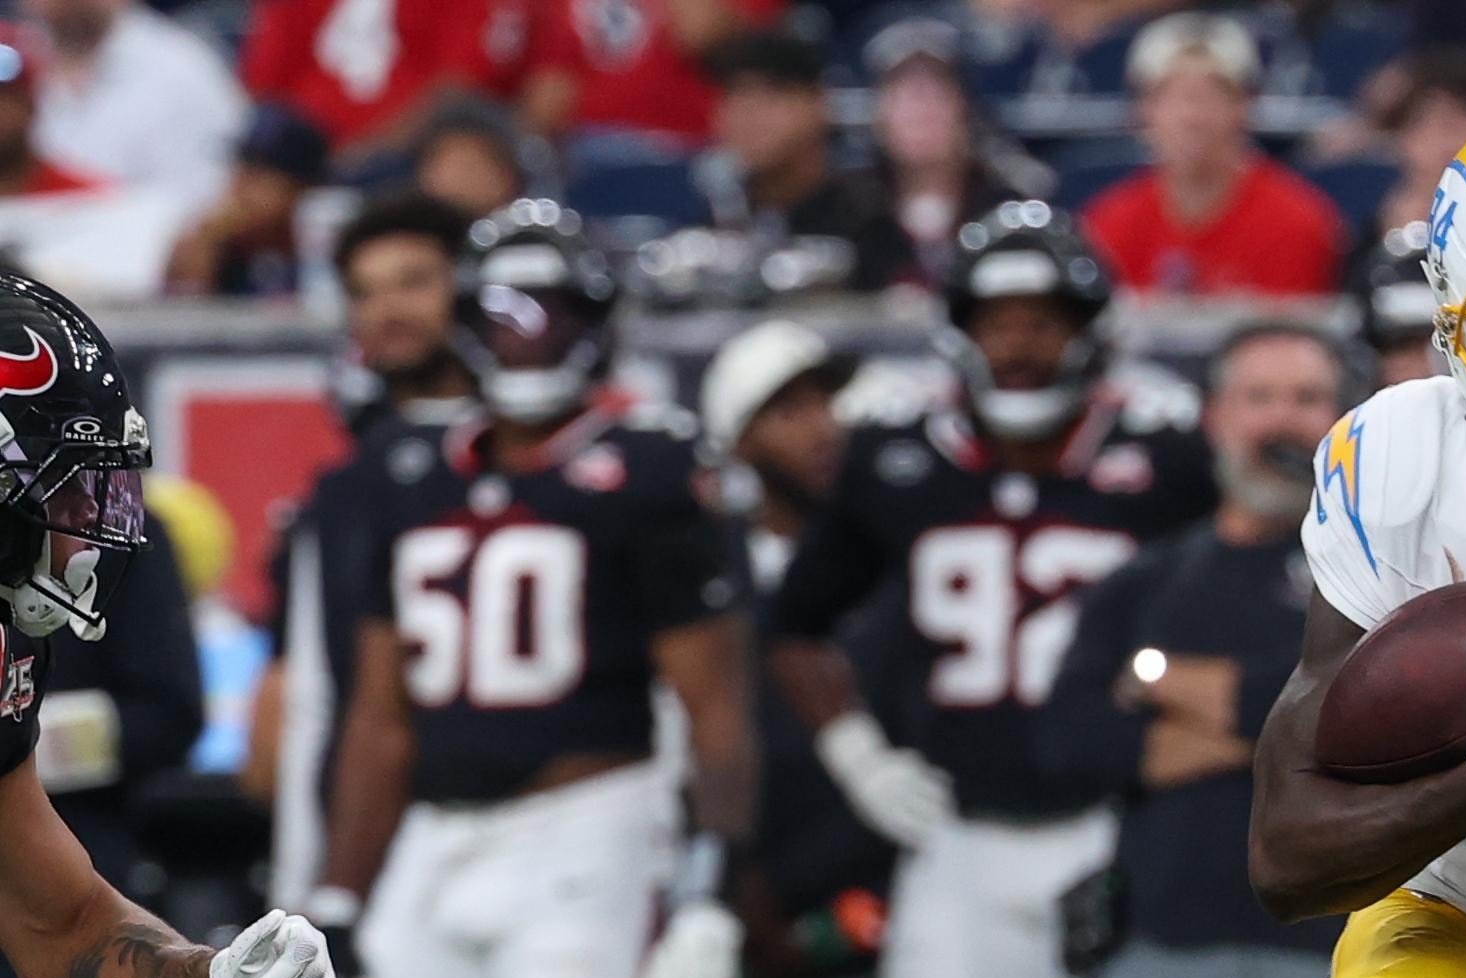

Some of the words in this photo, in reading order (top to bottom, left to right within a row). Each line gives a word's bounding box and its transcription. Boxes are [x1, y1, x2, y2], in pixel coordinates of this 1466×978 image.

[65, 432, 104, 441] OAKLEY
[391, 523, 588, 708] 50
[909, 524, 1138, 707] 92
